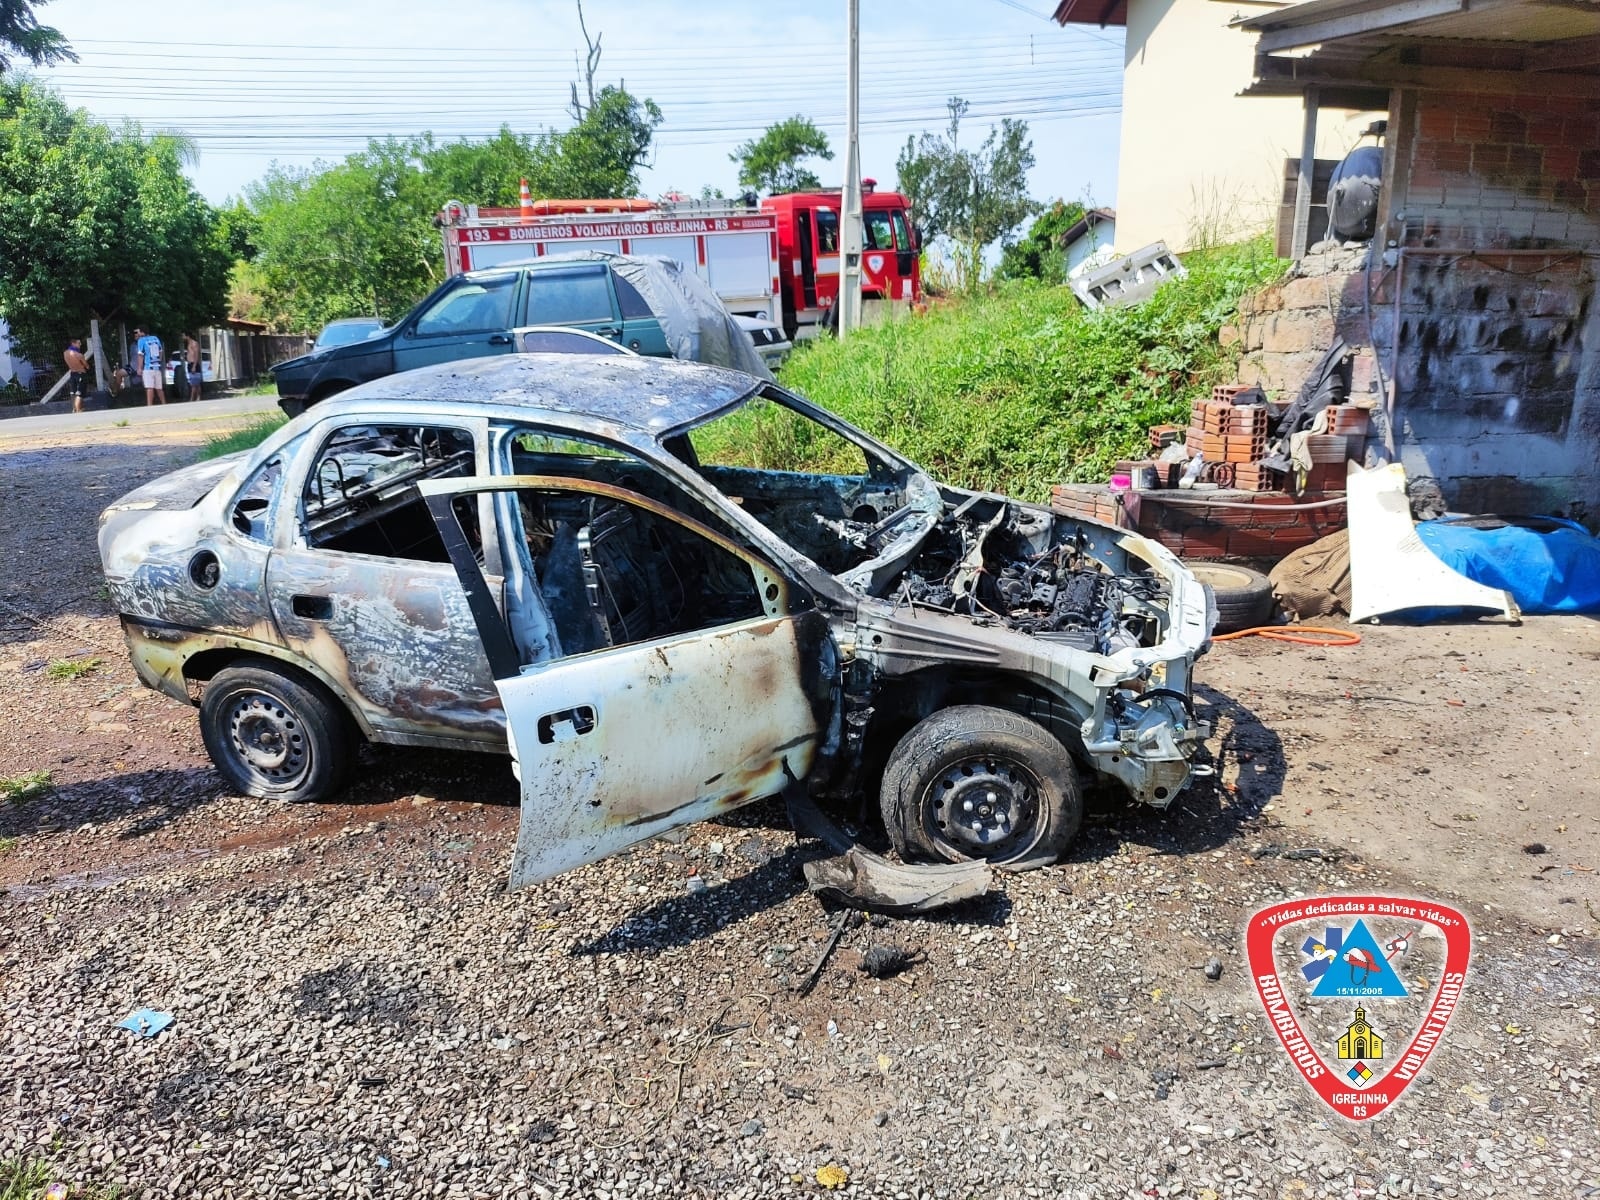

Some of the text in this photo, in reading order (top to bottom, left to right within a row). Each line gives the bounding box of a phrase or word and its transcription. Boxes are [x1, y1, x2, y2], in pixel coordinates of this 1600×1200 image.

[466, 229, 491, 241] 193
[509, 224, 573, 240] BOMBEIROS
[652, 220, 707, 234] IGREJINHA
[715, 219, 728, 230] RS
